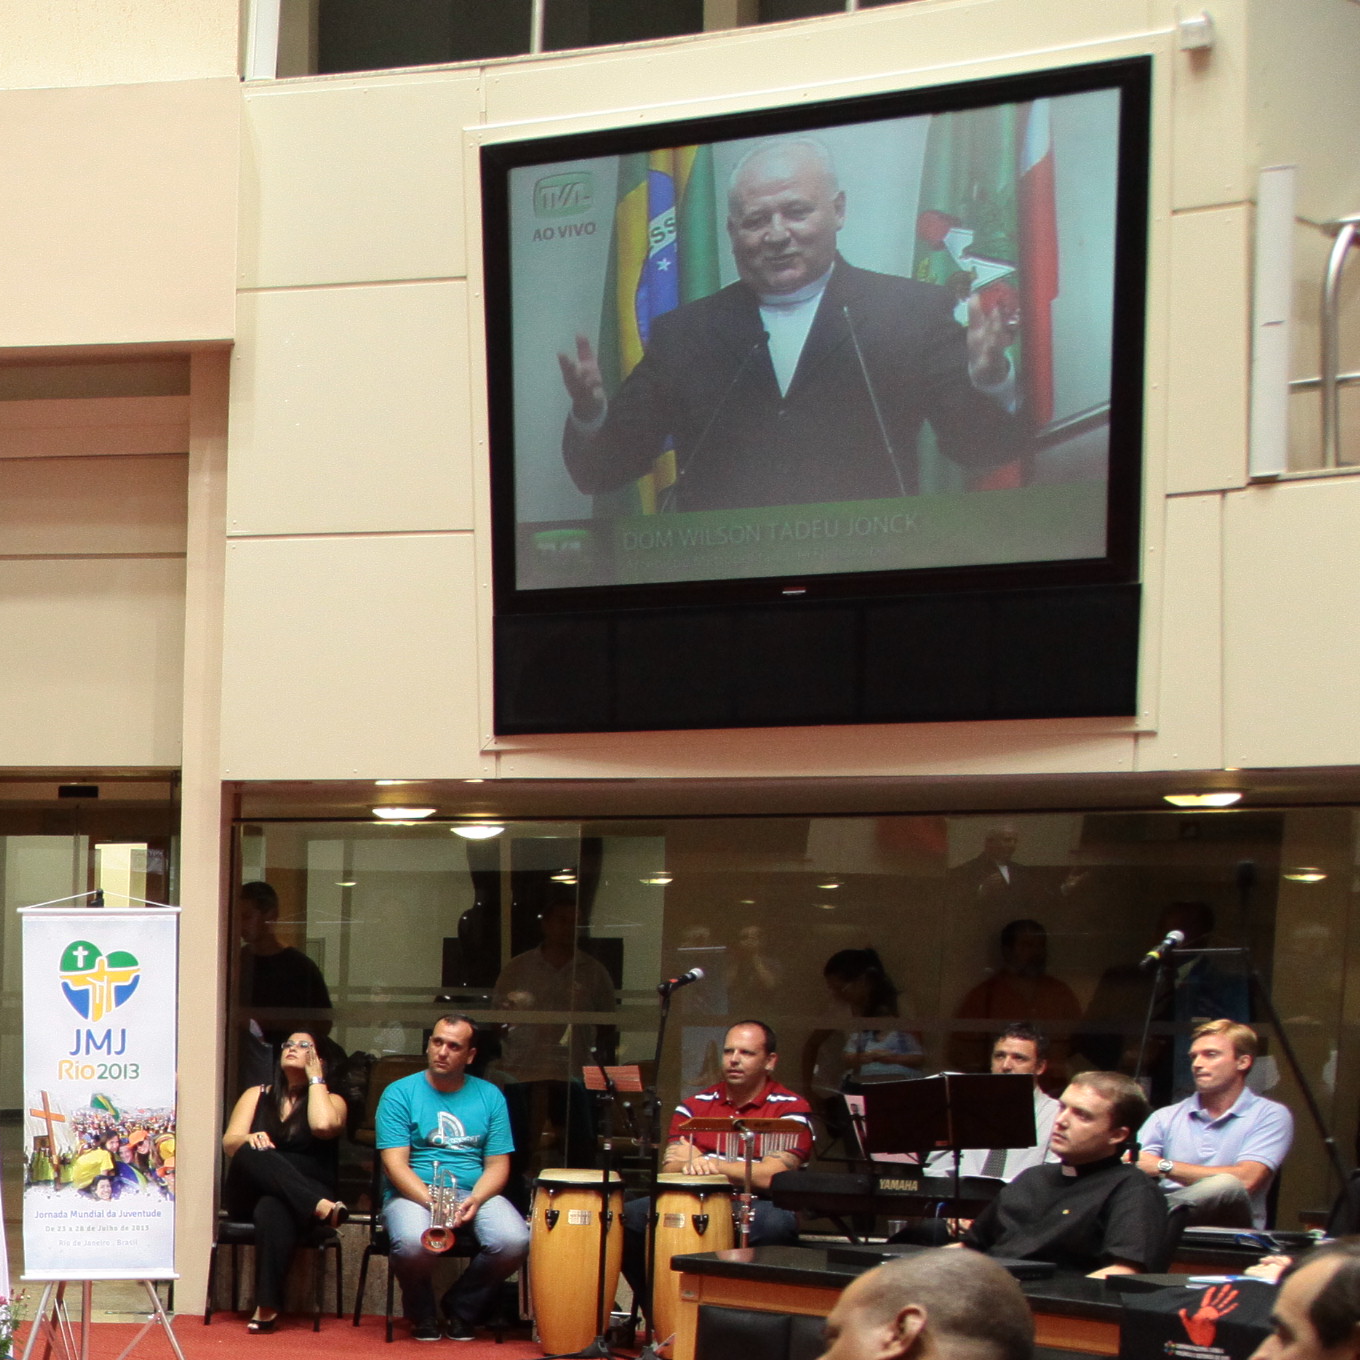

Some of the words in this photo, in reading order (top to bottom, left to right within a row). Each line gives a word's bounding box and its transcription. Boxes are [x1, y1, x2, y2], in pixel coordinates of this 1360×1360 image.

[533, 228, 555, 242] AO
[558, 222, 597, 238] VIVO
[623, 528, 673, 551] DOM
[679, 524, 761, 547] WILSON
[768, 519, 839, 541] TADEU
[69, 1028, 127, 1056] JMJ
[880, 1179, 919, 1192] YAMAHA
[34, 1210, 68, 1219] Jornada
[70, 1209, 105, 1219] Mundial
[106, 1209, 117, 1218] da
[118, 1209, 162, 1218] Juventude
